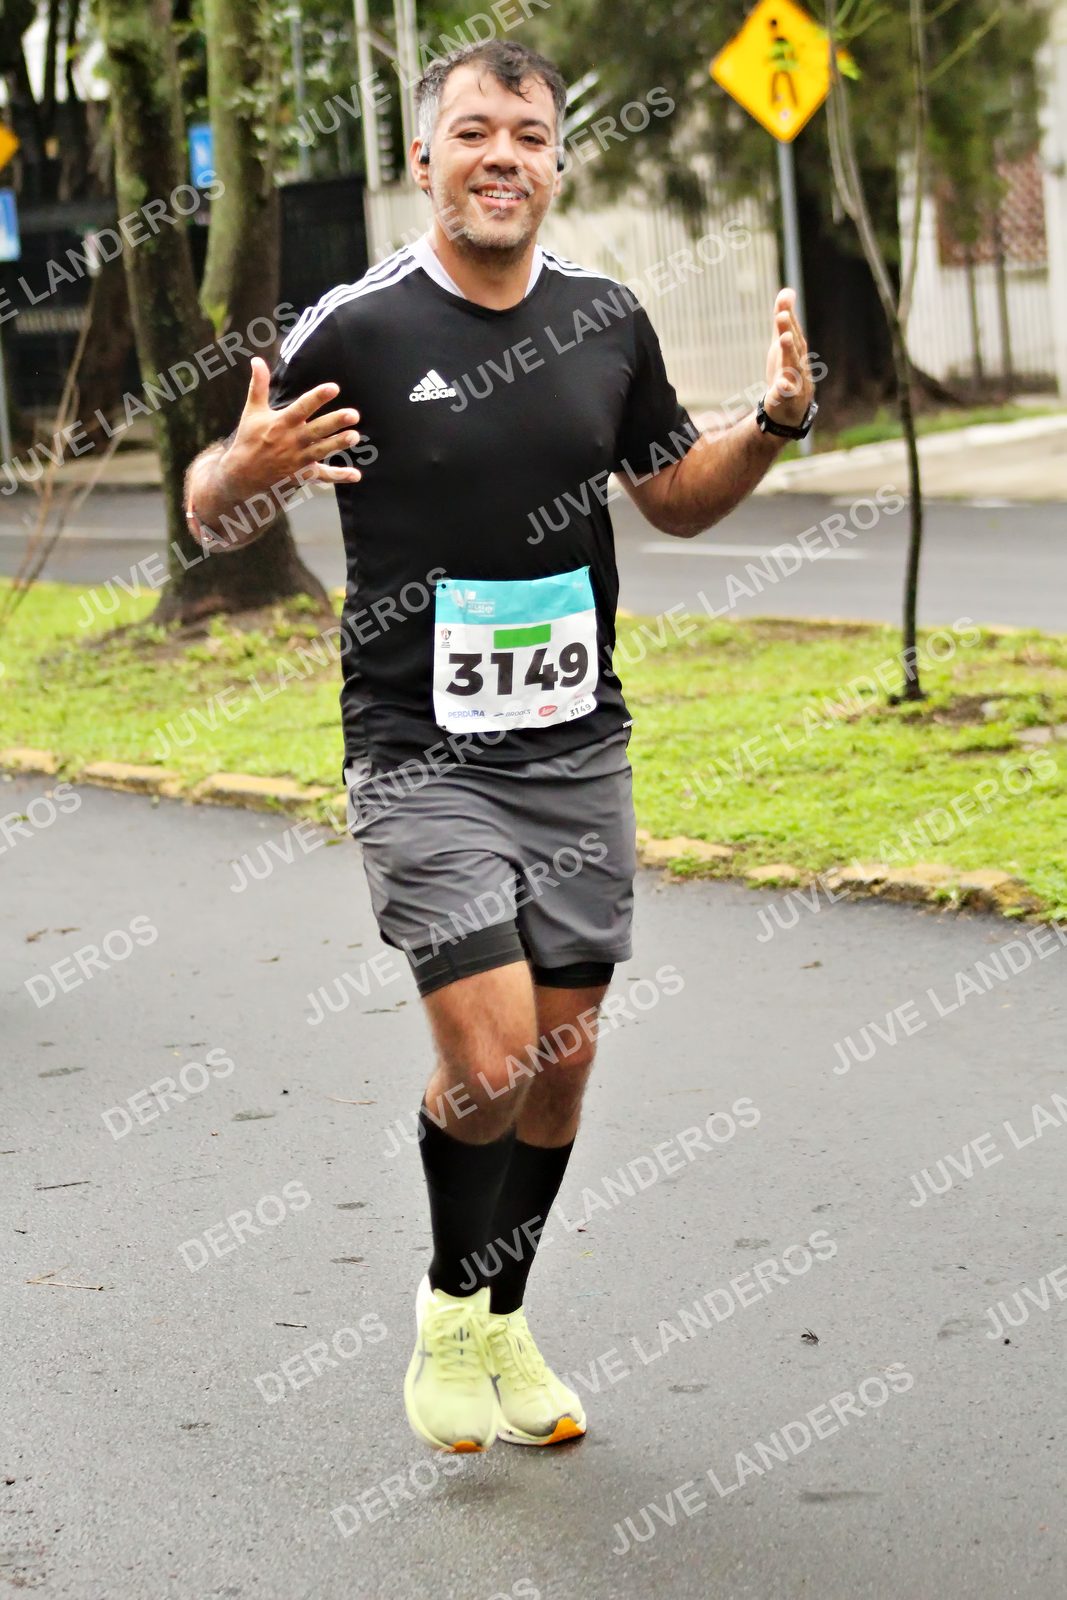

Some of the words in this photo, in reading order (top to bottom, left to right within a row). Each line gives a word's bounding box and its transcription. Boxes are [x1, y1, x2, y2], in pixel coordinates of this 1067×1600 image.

[409, 387, 456, 402] adidas
[446, 642, 588, 696] 3149
[448, 710, 485, 718] PERDURA
[570, 704, 592, 717] 3149
